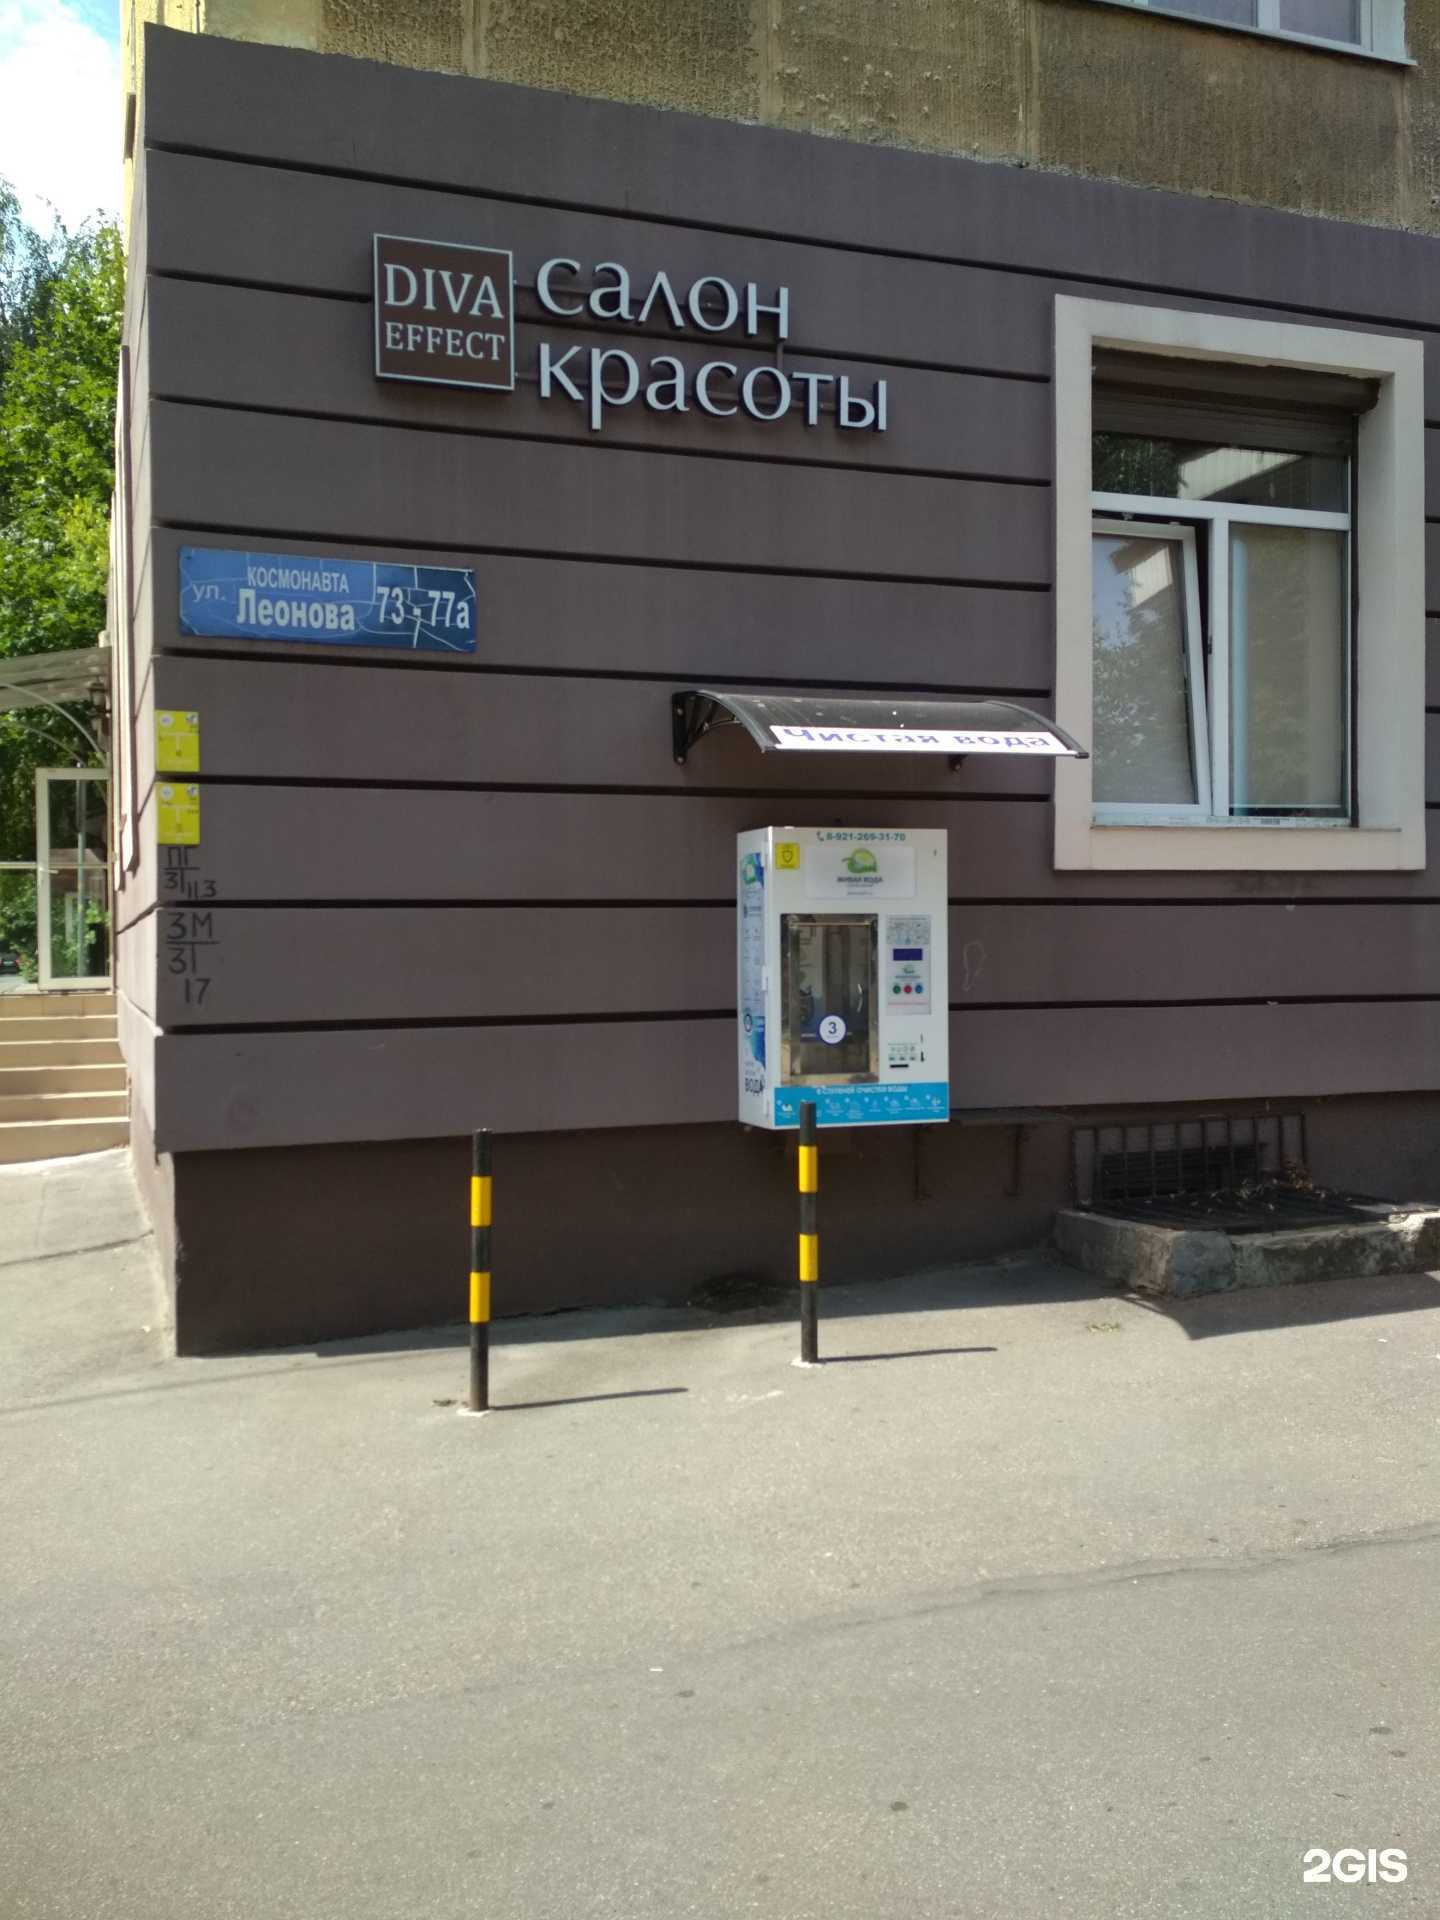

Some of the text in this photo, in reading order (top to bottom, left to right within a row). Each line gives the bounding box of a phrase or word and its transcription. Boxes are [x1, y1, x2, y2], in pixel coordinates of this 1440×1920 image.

[383, 263, 505, 319] DIVA
[536, 257, 790, 340] салон
[384, 323, 505, 361] EFFECT
[539, 342, 887, 431] красоты
[247, 566, 350, 593] КОСМОНАВТА
[192, 583, 355, 631] ул. Леонова
[783, 728, 1052, 748] Чистая вода
[828, 1021, 838, 1034] 3
